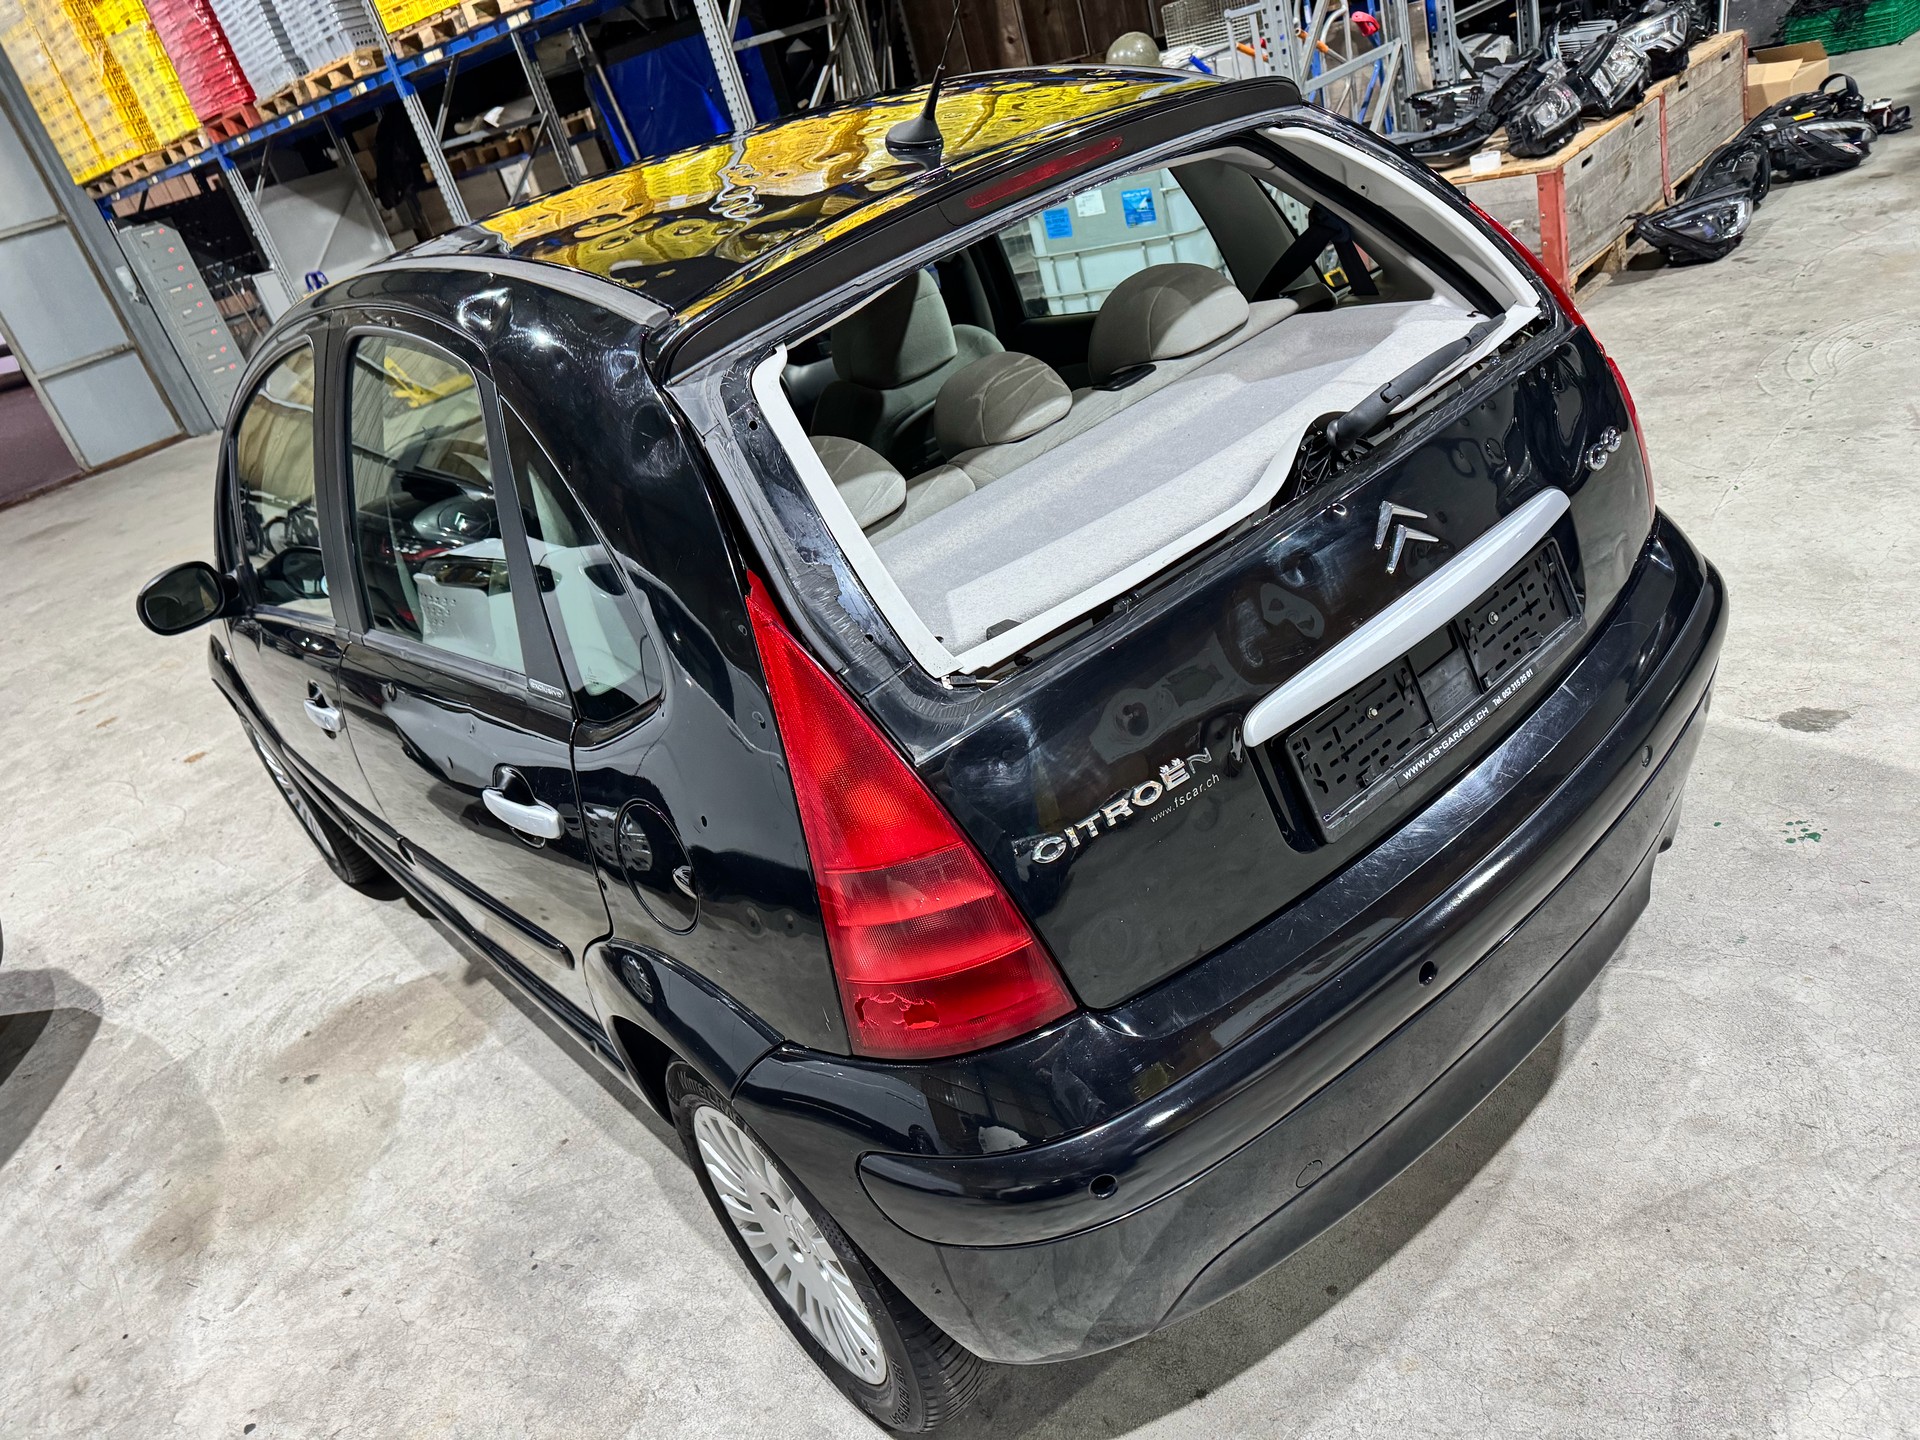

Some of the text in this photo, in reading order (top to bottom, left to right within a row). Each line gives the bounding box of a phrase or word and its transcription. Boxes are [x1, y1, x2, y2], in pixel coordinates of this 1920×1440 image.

[1402, 706, 1490, 780] WWW.AS-GARAGE.CH
[1501, 687, 1512, 699] 052
[1511, 679, 1521, 690] 315
[1519, 673, 1528, 684] 25
[1525, 668, 1534, 678] 01
[1031, 747, 1213, 864] CITROËN
[1150, 772, 1220, 824] www.fscar.ch
